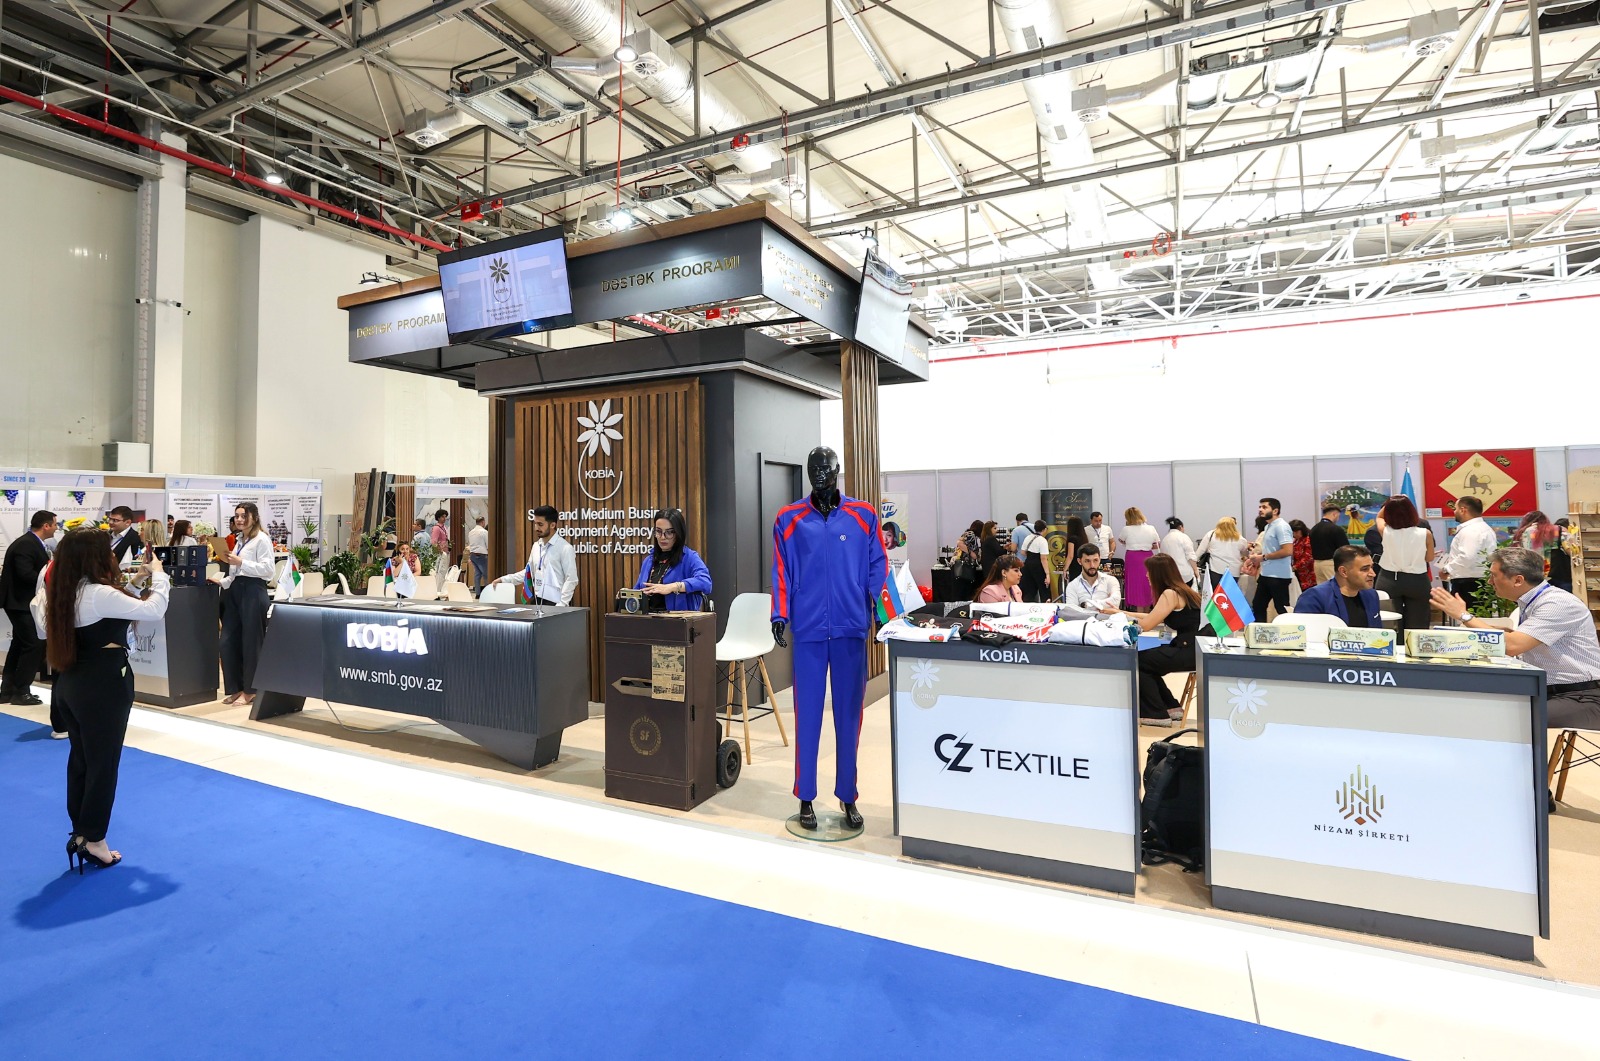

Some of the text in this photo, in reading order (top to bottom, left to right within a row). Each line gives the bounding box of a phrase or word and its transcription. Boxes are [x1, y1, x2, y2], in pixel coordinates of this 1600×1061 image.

[602, 255, 740, 292] DƏSTƏK PROQRAMI
[356, 313, 446, 338] DƏSTƏK PROQRAM
[585, 467, 615, 479] KOBİA
[558, 508, 578, 521] and
[581, 507, 625, 520] Medium
[610, 525, 654, 540] Agency
[573, 542, 655, 554] ublic of Azerba
[346, 618, 429, 655] KOBİA
[1332, 640, 1365, 650] BUTAT
[979, 647, 1030, 664] KOBİA
[339, 666, 443, 692] www.smb.gov.az
[1328, 668, 1397, 686] KOBİA
[980, 748, 1090, 780] TEXTILE
[1314, 824, 1410, 842] NİZAM ŞİRKETİ
